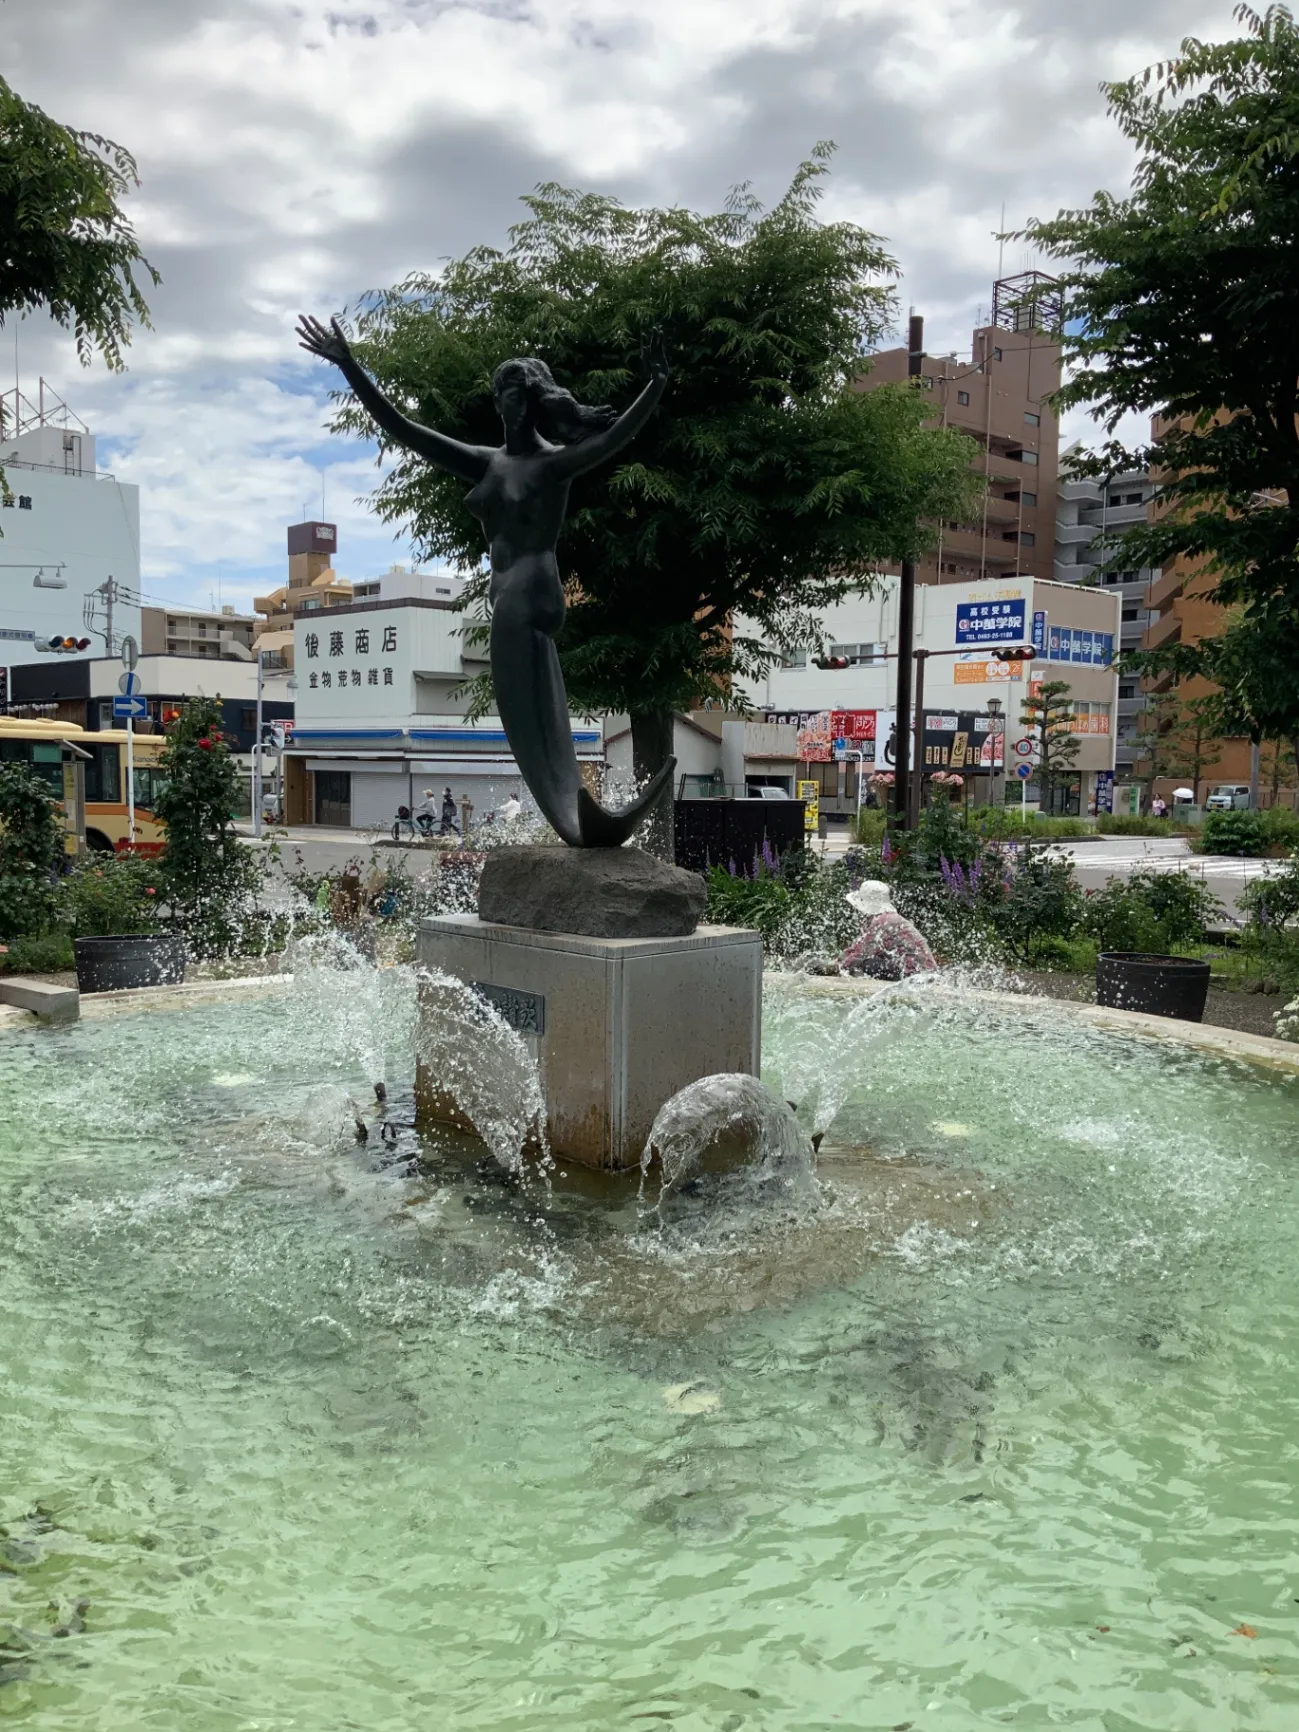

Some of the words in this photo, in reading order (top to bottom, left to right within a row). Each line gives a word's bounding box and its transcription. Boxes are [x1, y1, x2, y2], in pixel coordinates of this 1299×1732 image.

[970, 605, 1011, 617] 高校受験
[305, 625, 397, 658] 後藤商店
